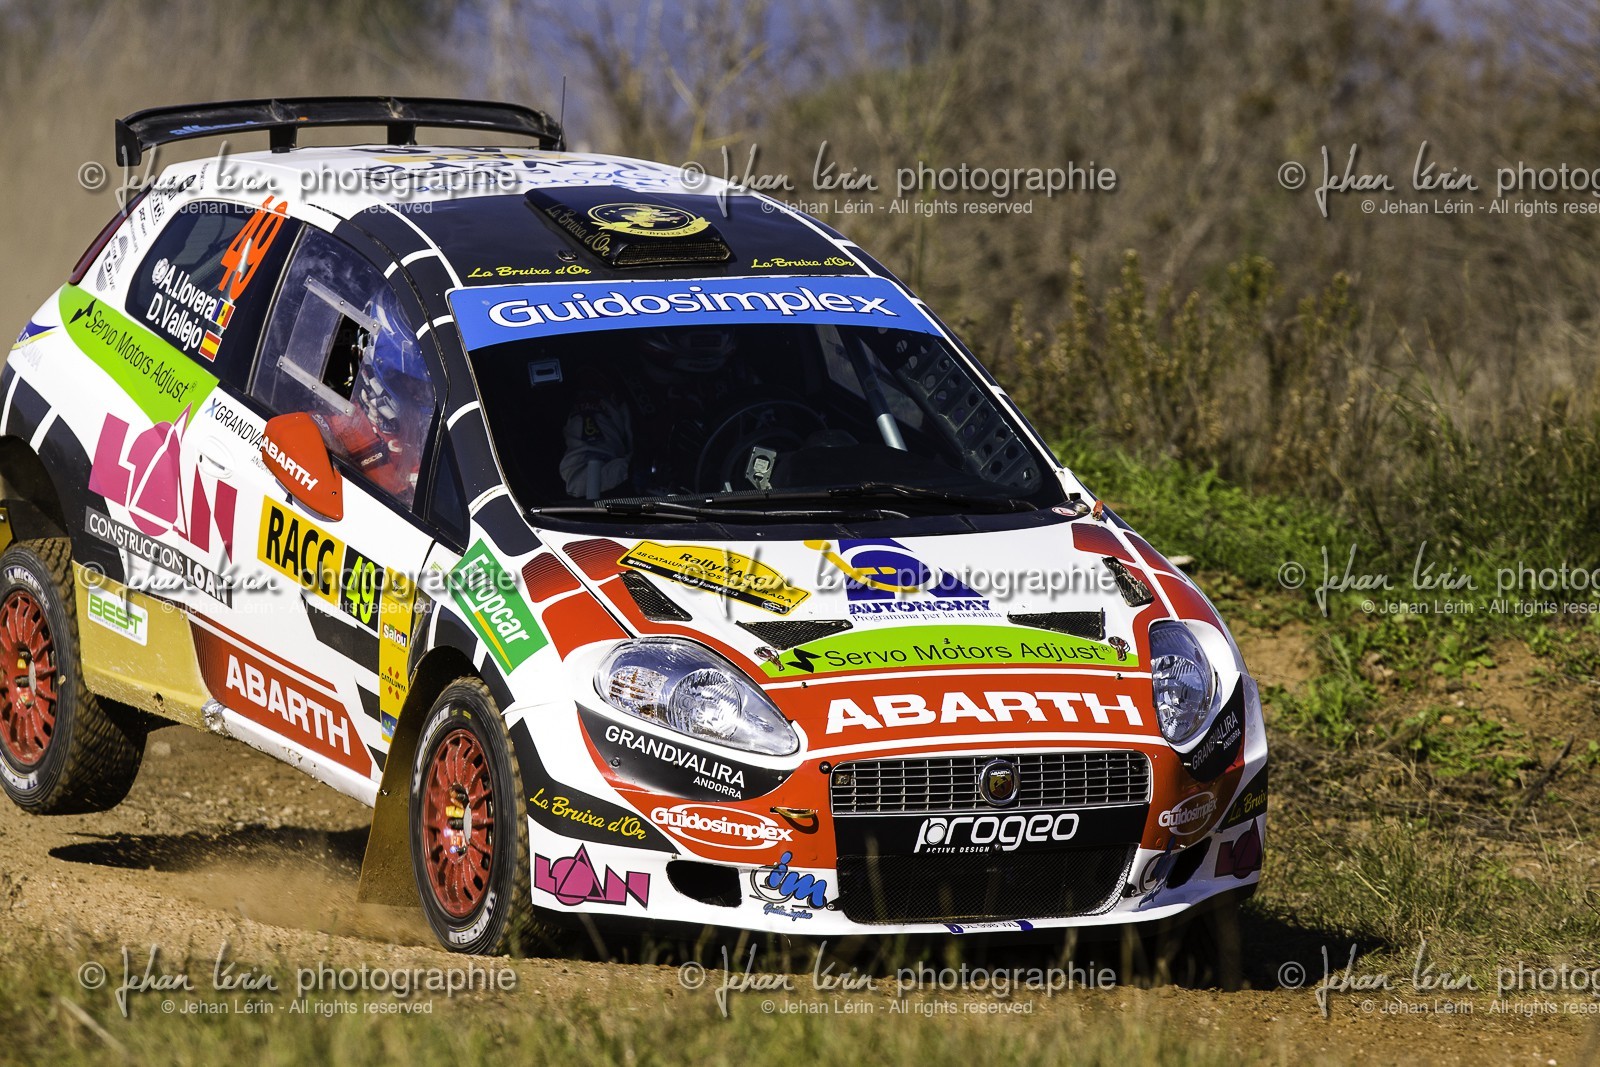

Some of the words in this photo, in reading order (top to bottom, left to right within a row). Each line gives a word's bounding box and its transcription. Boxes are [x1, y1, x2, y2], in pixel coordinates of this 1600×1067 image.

[218, 195, 288, 300] 49
[751, 258, 769, 269] La
[770, 257, 821, 268] Bruixa
[467, 267, 493, 279] La
[495, 266, 551, 277] Bruixa
[146, 292, 202, 350] D.Vallejo
[488, 286, 899, 327] Guidosimplex
[85, 310, 118, 346] Servo
[115, 331, 154, 375] Motors
[261, 436, 319, 491] ABARTH
[89, 513, 184, 575] CONSTRUCCIONS
[265, 505, 335, 596] RACC
[346, 555, 375, 624] 49
[459, 553, 530, 645] Europcar
[849, 600, 991, 615] AUTONOMY
[383, 624, 407, 648] Salou
[852, 611, 920, 624] Programma
[922, 612, 941, 622] per
[824, 646, 907, 667] Servo
[913, 643, 1012, 662] Motors
[381, 672, 407, 693] CATALUNYA
[225, 653, 351, 756] ABARTH
[825, 691, 1144, 735] ABARTH
[604, 724, 746, 788] GRANDVALIRA
[530, 787, 549, 810] La
[552, 796, 605, 830] Bruixa
[693, 776, 743, 800] ANDORRA
[650, 806, 795, 842] Guidosimplex
[914, 814, 1080, 853] progeo
[926, 846, 955, 854] ACTIVE
[959, 845, 990, 853] DESIGN
